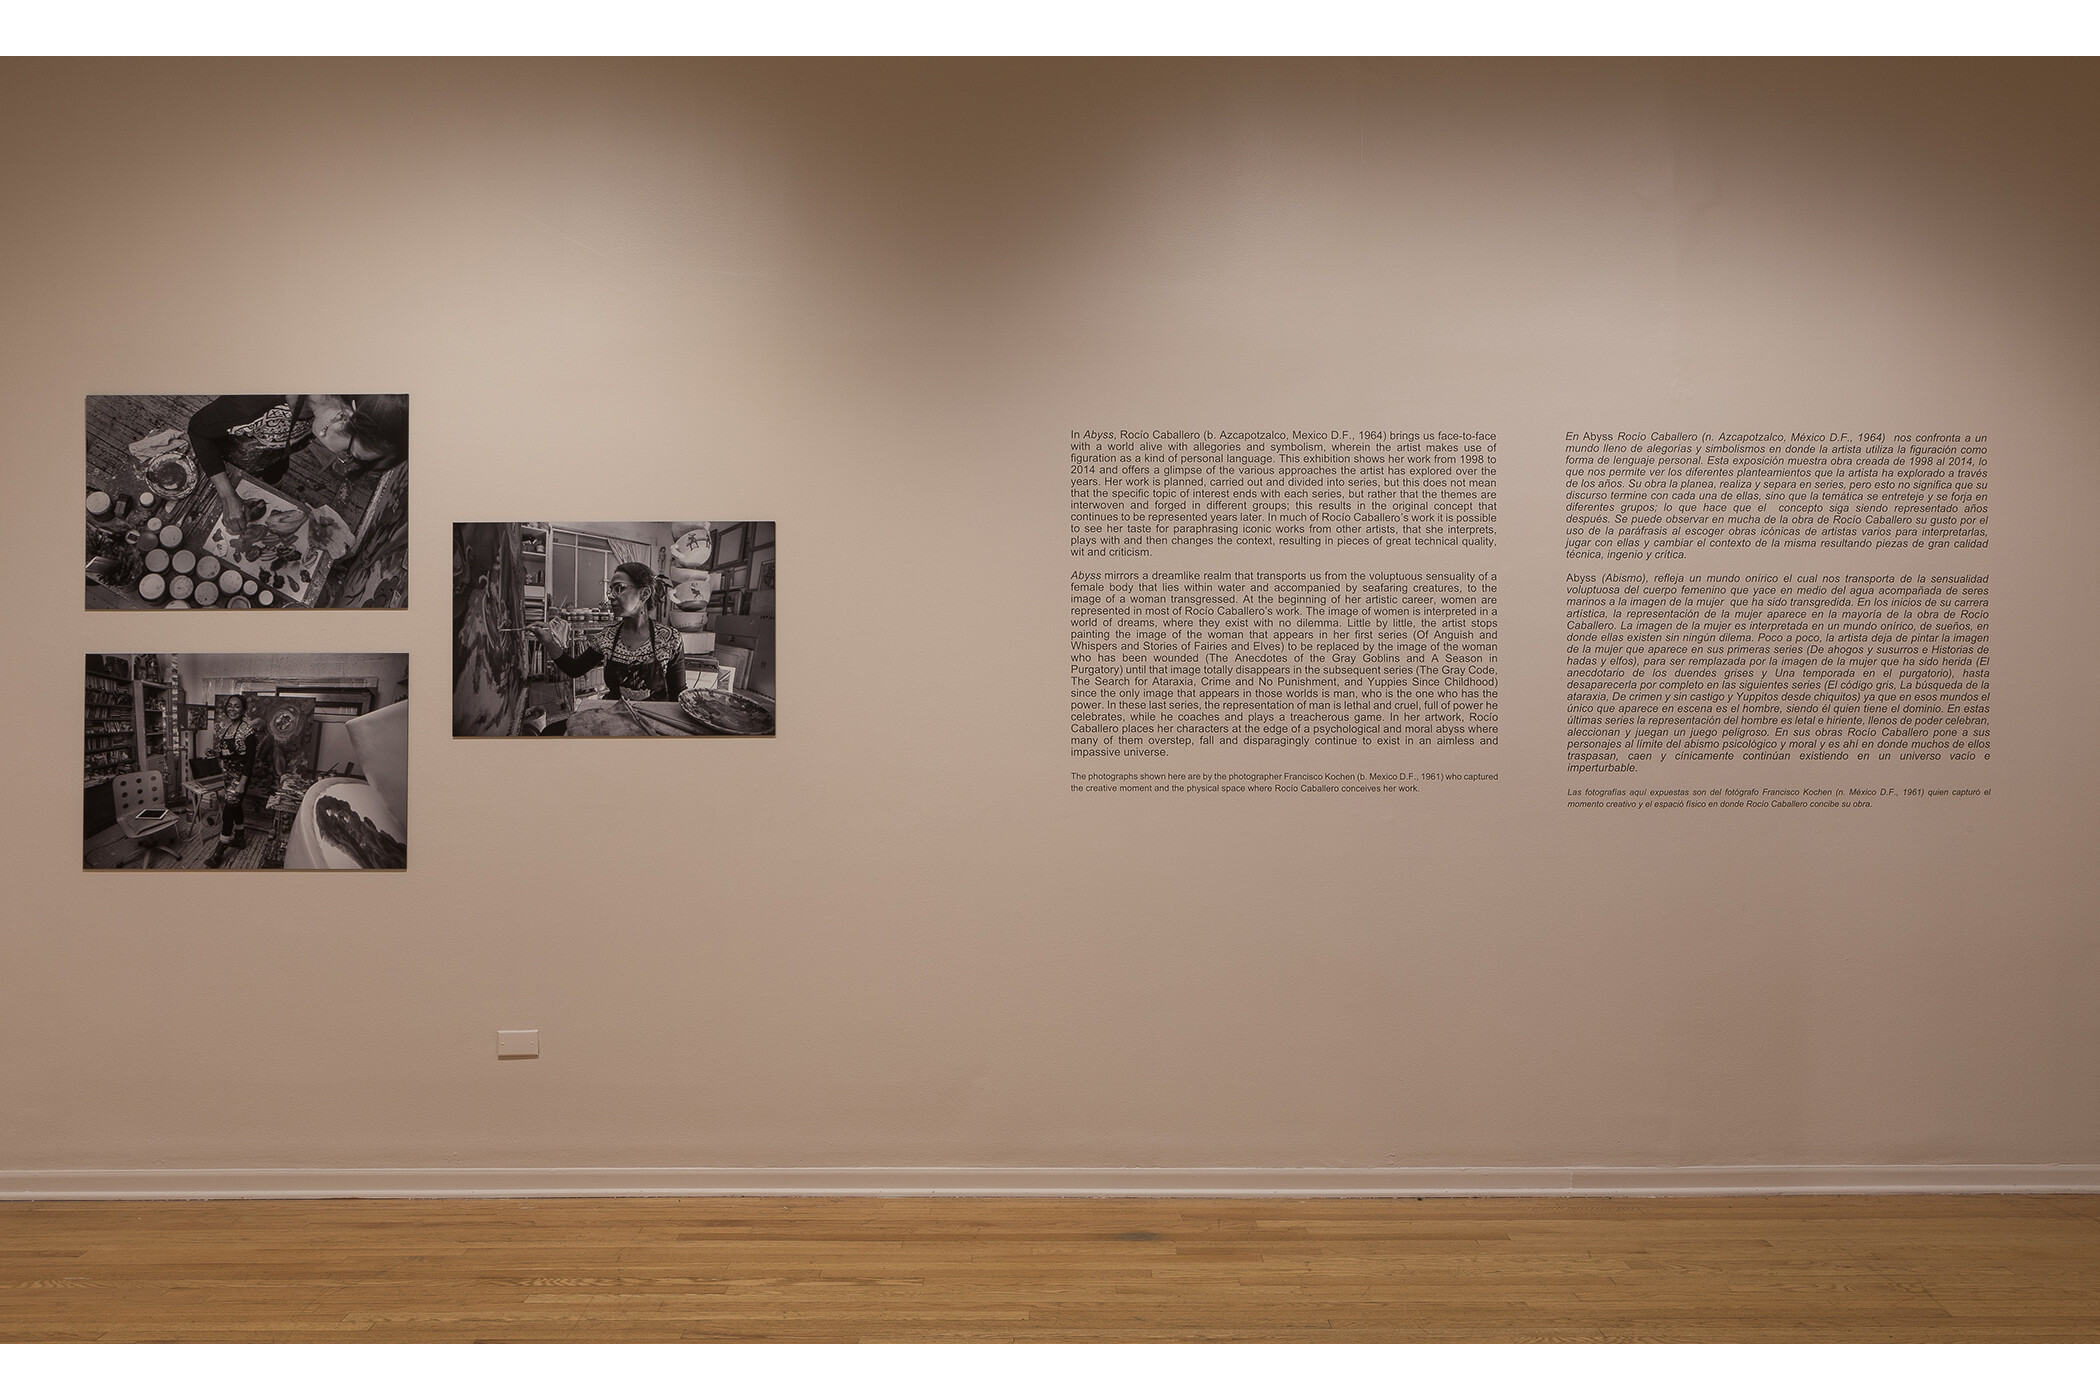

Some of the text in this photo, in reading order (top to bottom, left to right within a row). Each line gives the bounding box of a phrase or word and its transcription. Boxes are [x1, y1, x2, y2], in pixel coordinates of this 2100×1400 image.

[1071, 430, 1080, 439] In
[1083, 430, 1116, 441] Abyss,
[1120, 430, 1149, 439] Rocío
[1153, 430, 1200, 439] Caballero
[1204, 430, 1216, 441] (b.
[1219, 430, 1288, 441] Azcapotzalco,
[1293, 431, 1327, 439] Mexico
[1359, 431, 1386, 442] 1964)
[1390, 431, 1420, 442] brings
[1438, 431, 1496, 440] face-to-face
[1565, 432, 1579, 440] En
[1582, 432, 1614, 443] Abyss
[1617, 432, 1647, 441] Rocío
[1650, 432, 1698, 441] Caballero
[1702, 432, 1714, 443] (n.
[1718, 432, 1786, 443] Azcapotzalco,
[1790, 433, 1826, 442] México
[1859, 433, 1885, 443] 1964)
[1915, 433, 1961, 442] confronta
[1071, 465, 1095, 474] 2014
[1099, 465, 1118, 474] and
[1122, 465, 1150, 474] offers
[1164, 465, 1202, 476] glimpse
[1206, 465, 1216, 474] of
[1219, 466, 1235, 474] the
[1239, 465, 1274, 475] various
[1279, 466, 1337, 476] approaches
[1341, 466, 1356, 475] the
[1360, 466, 1384, 475] artist
[1388, 466, 1406, 475] has
[1410, 466, 1451, 477] explored
[1481, 467, 1496, 475] the
[1566, 585, 1620, 596] voluptuosa
[1624, 585, 1640, 594] del
[1643, 587, 1677, 596] cuerpo
[1681, 585, 1727, 594] femenino
[1730, 587, 1749, 596] que
[1752, 587, 1776, 596] yace
[1796, 586, 1827, 594] medio
[1831, 586, 1846, 594] del
[1849, 587, 1874, 597] agua
[1878, 586, 1942, 596] acompañada
[1945, 586, 1958, 595] de
[1071, 665, 1497, 677] Purgatory) until that image totally disappears in the subsequent series (The Gray Code,
[1071, 676, 1498, 688] The Search for Ataraxia, Crime and No Punishment, and Yuppies Since Childhood)
[1566, 680, 1637, 691] desaparecerla
[1639, 682, 1657, 691] por
[1659, 680, 1704, 691] completo
[1721, 680, 1736, 689] las
[1739, 680, 1789, 691] siguientes
[1791, 680, 1821, 689] series
[1824, 680, 1838, 691] (El
[1840, 680, 1873, 691] código
[1875, 680, 1896, 691] gris,
[1900, 681, 1912, 689] La
[1915, 680, 1963, 691] búsqueda
[1965, 681, 1978, 689] de
[1981, 681, 1990, 689] la
[1071, 772, 1086, 780] The
[1088, 773, 1138, 782] photographs
[1203, 773, 1212, 782] by
[1229, 773, 1282, 782] photographer
[1357, 773, 1367, 782] (b.
[1422, 773, 1444, 782] 1961)
[1464, 773, 1498, 781] captured
[1071, 784, 1083, 792] the
[1086, 784, 1117, 792] creative
[1187, 784, 1219, 793] physical
[1301, 784, 1339, 792] Caballero
[1585, 788, 1626, 797] fotografías
[1629, 789, 1647, 797] aquí
[1650, 789, 1689, 797] expuestas
[1725, 788, 1759, 797] fotógrafo
[1762, 788, 1800, 796] Francisco
[1803, 788, 1832, 796] Kochen
[1836, 788, 1845, 797] (n.
[1849, 788, 1877, 796] México
[1904, 788, 1924, 797] 1961)
[1928, 789, 1949, 797] quien
[1952, 789, 1981, 797] capturó
[1654, 800, 1684, 809] espació
